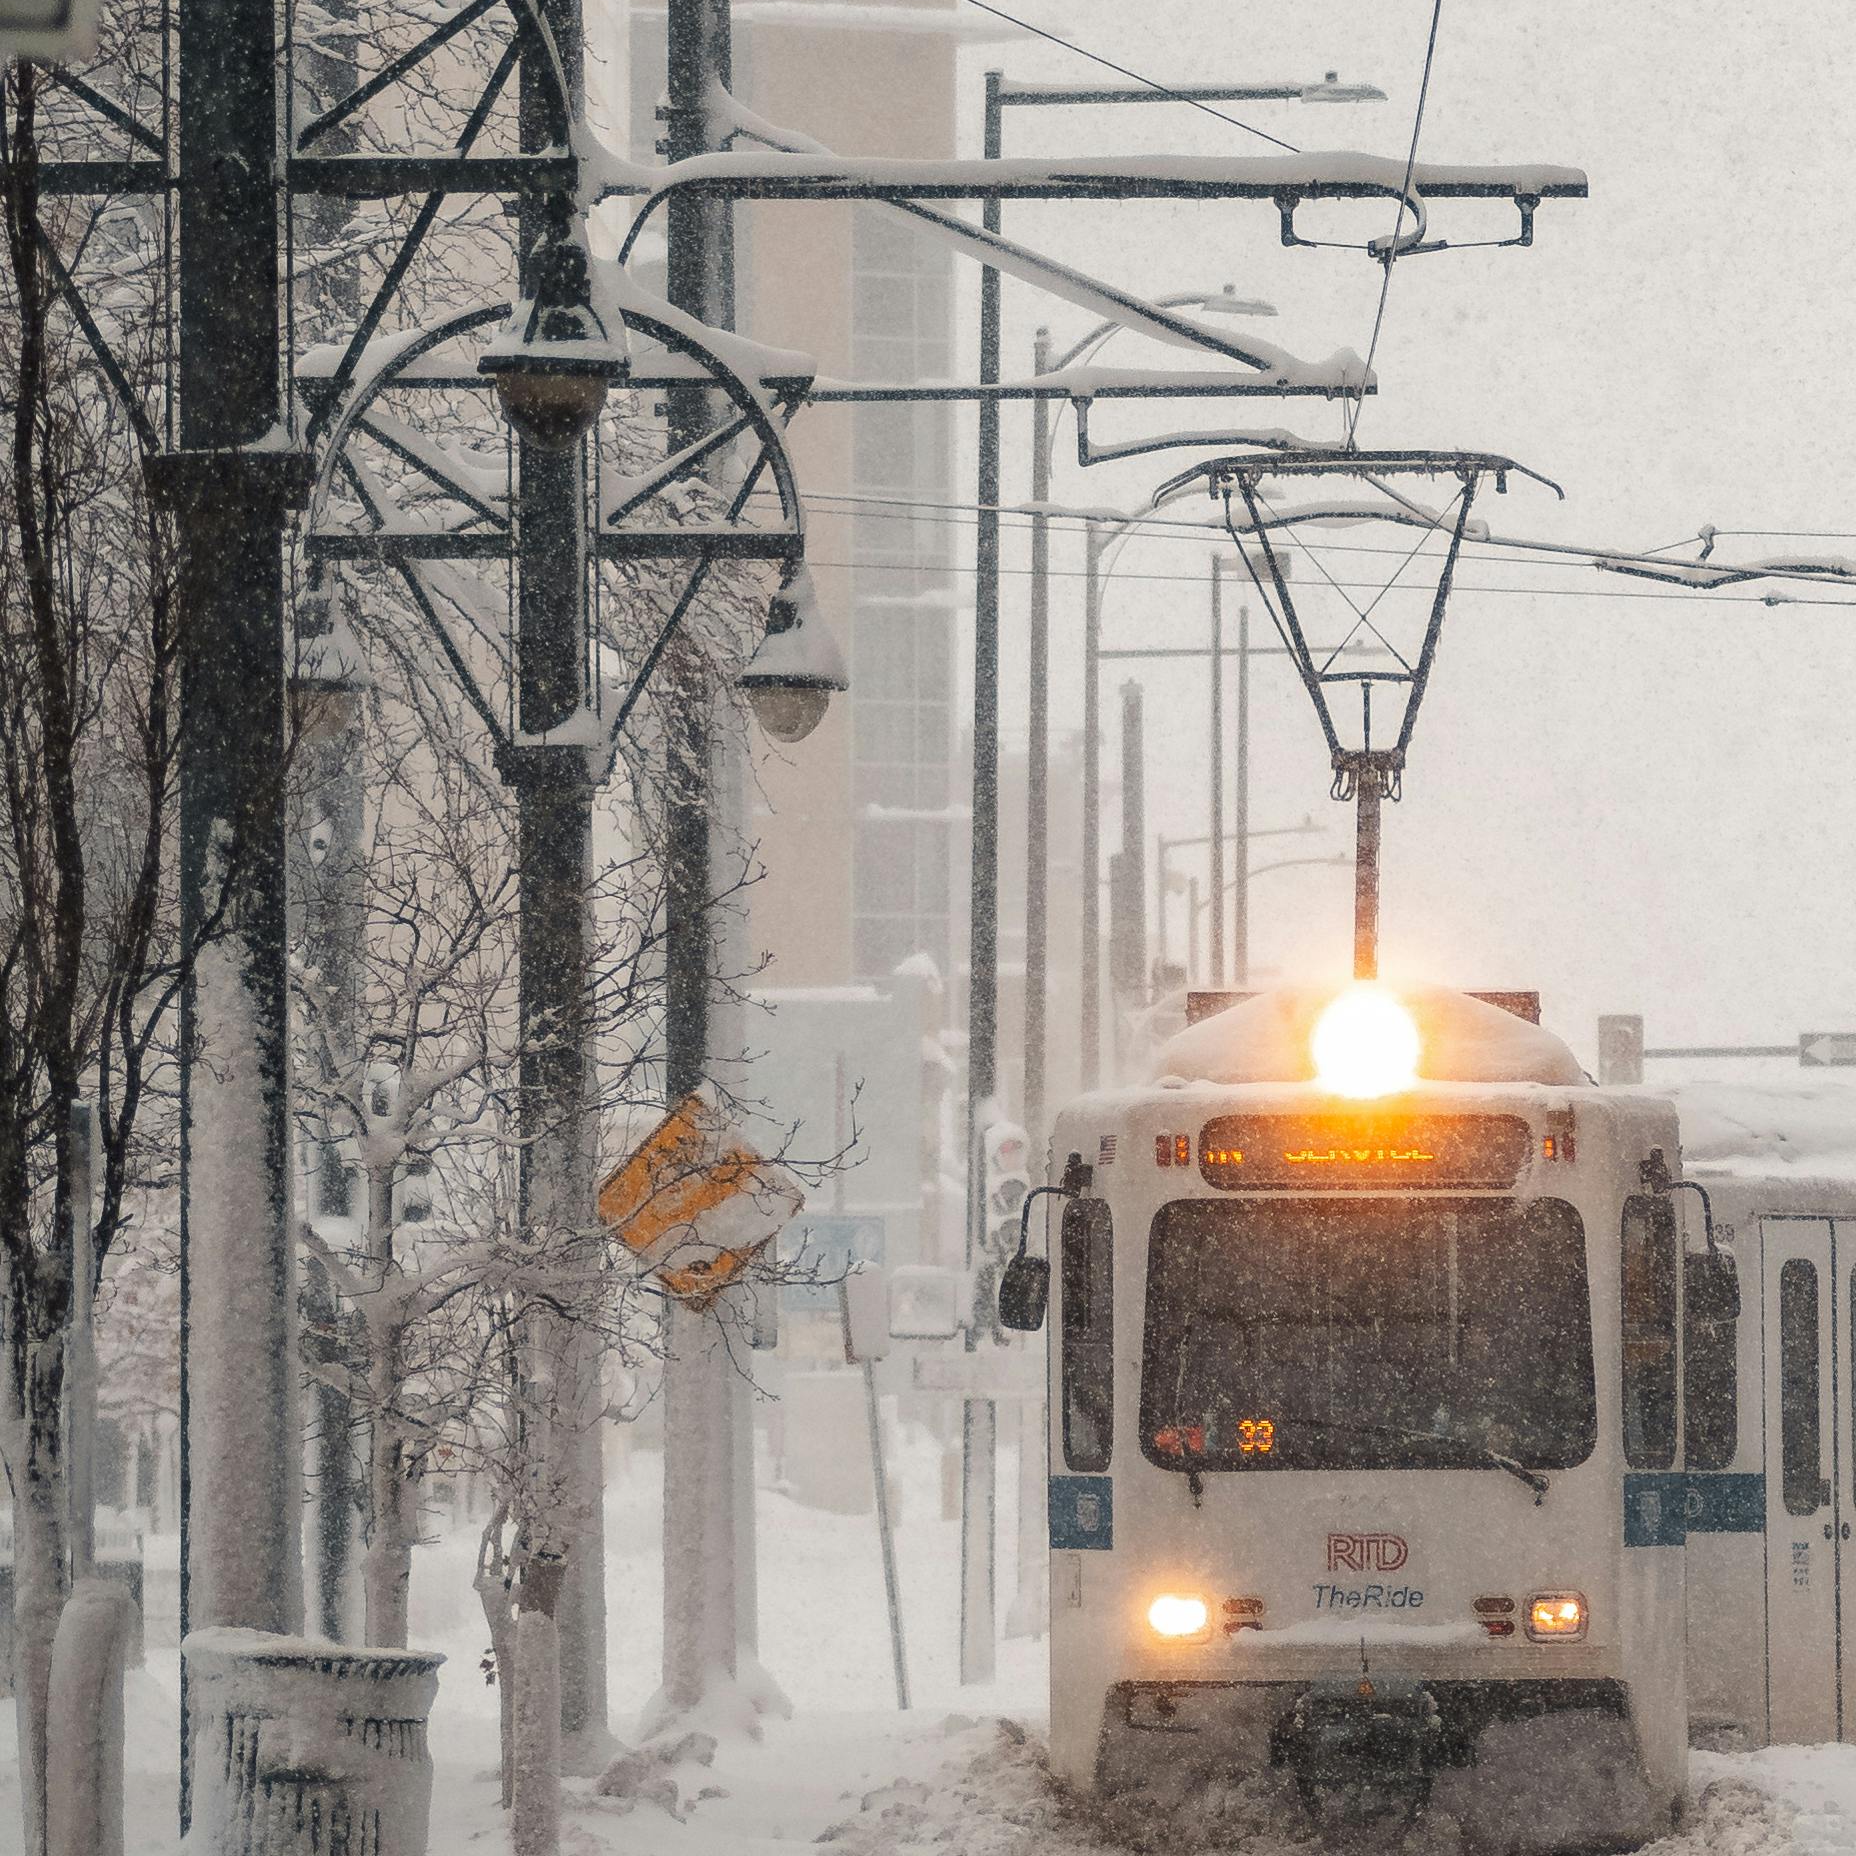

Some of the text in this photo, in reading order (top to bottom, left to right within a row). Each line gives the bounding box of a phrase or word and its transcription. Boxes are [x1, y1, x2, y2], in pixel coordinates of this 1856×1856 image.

[1238, 1419, 1275, 1452] 33
[1327, 1533, 1409, 1572] RTD
[1312, 1584, 1424, 1609] TheRide
